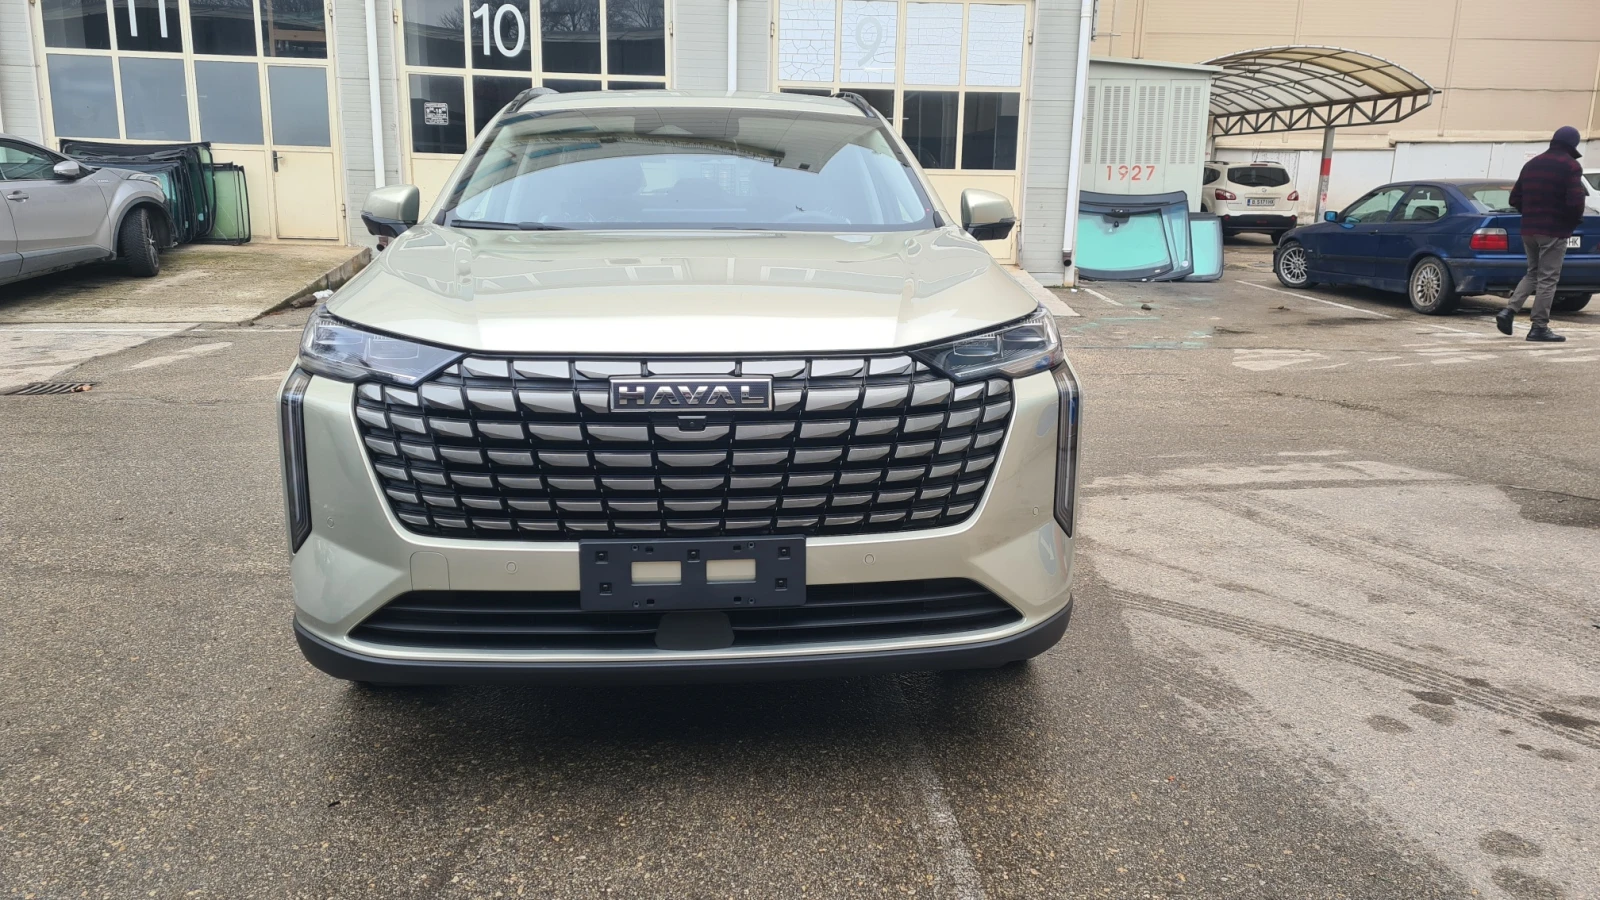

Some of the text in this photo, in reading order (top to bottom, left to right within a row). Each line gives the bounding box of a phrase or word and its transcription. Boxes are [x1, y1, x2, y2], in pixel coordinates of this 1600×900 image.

[473, 3, 525, 57] 10
[855, 16, 883, 67] 9
[1106, 165, 1156, 181] 1927
[618, 385, 765, 405] HAVAL
